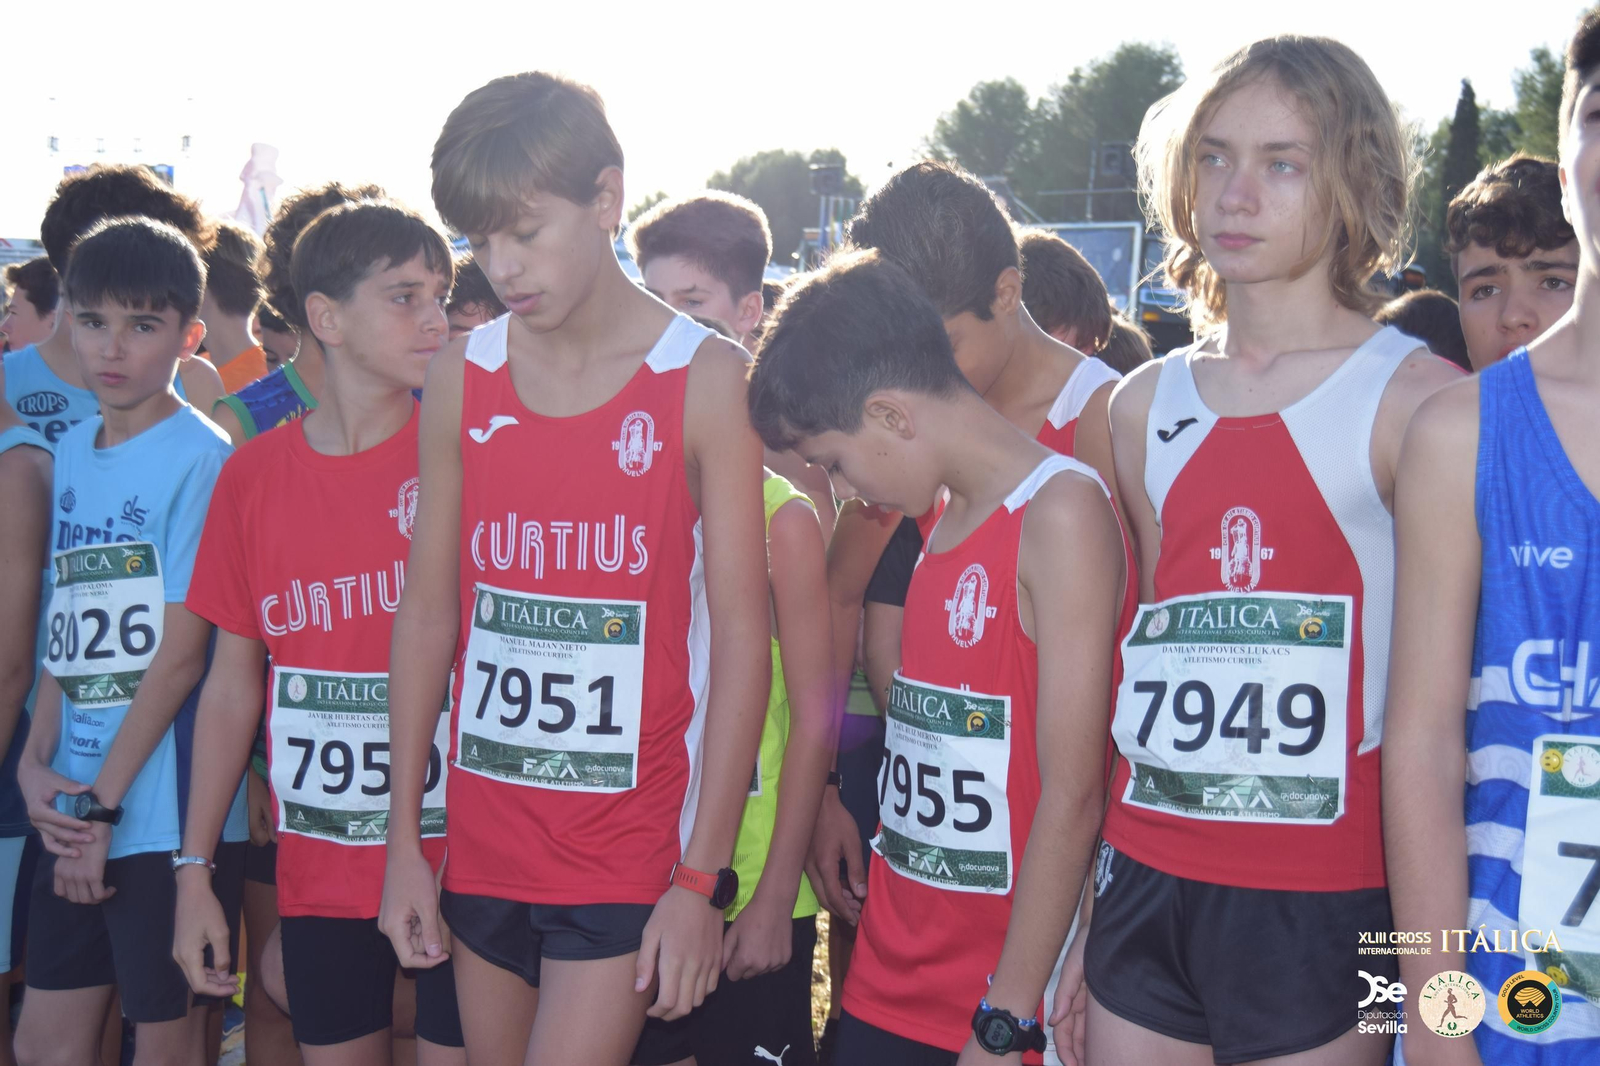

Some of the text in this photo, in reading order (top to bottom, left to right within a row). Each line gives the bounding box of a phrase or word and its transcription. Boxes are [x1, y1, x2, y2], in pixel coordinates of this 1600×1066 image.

[20, 393, 67, 412] TROPS
[622, 467, 650, 477] HUELVA
[388, 509, 398, 518] 19
[471, 513, 649, 580] CURTIUS
[1208, 548, 1274, 560] 19 67
[1509, 540, 1573, 569] vive
[83, 582, 113, 590] PALOMA
[261, 560, 405, 636] CURTIU
[501, 600, 589, 630] ITÁLICA
[985, 606, 998, 619] 67
[1177, 601, 1280, 629] ITÁLICA
[48, 604, 156, 663] 8026
[500, 636, 587, 652] MANUEL MAJAN NIETO
[951, 634, 979, 649] HUELVA
[508, 647, 573, 659] ATLETISMO CURTIUS
[1162, 646, 1291, 655] DAMIAN POPOVICS LUKACS
[1183, 656, 1262, 664] ATLETISMO CURTIUS
[317, 678, 388, 702] ITÁLIC
[475, 660, 623, 735] 7951
[892, 685, 952, 720] ITÁLICA
[335, 713, 371, 721] HUERTAS
[1134, 680, 1326, 757] 7949
[917, 730, 942, 742] MERINO
[522, 758, 579, 779] FAA
[592, 764, 625, 772] docunova
[507, 774, 538, 783] ANDALUZA
[1202, 787, 1273, 808] FAA
[1289, 791, 1330, 801] docunova
[1187, 808, 1222, 817] ANDALUZA
[1239, 811, 1280, 819] ATLETISMO
[965, 863, 999, 872] docunova
[929, 876, 960, 886] ATLETISMO
